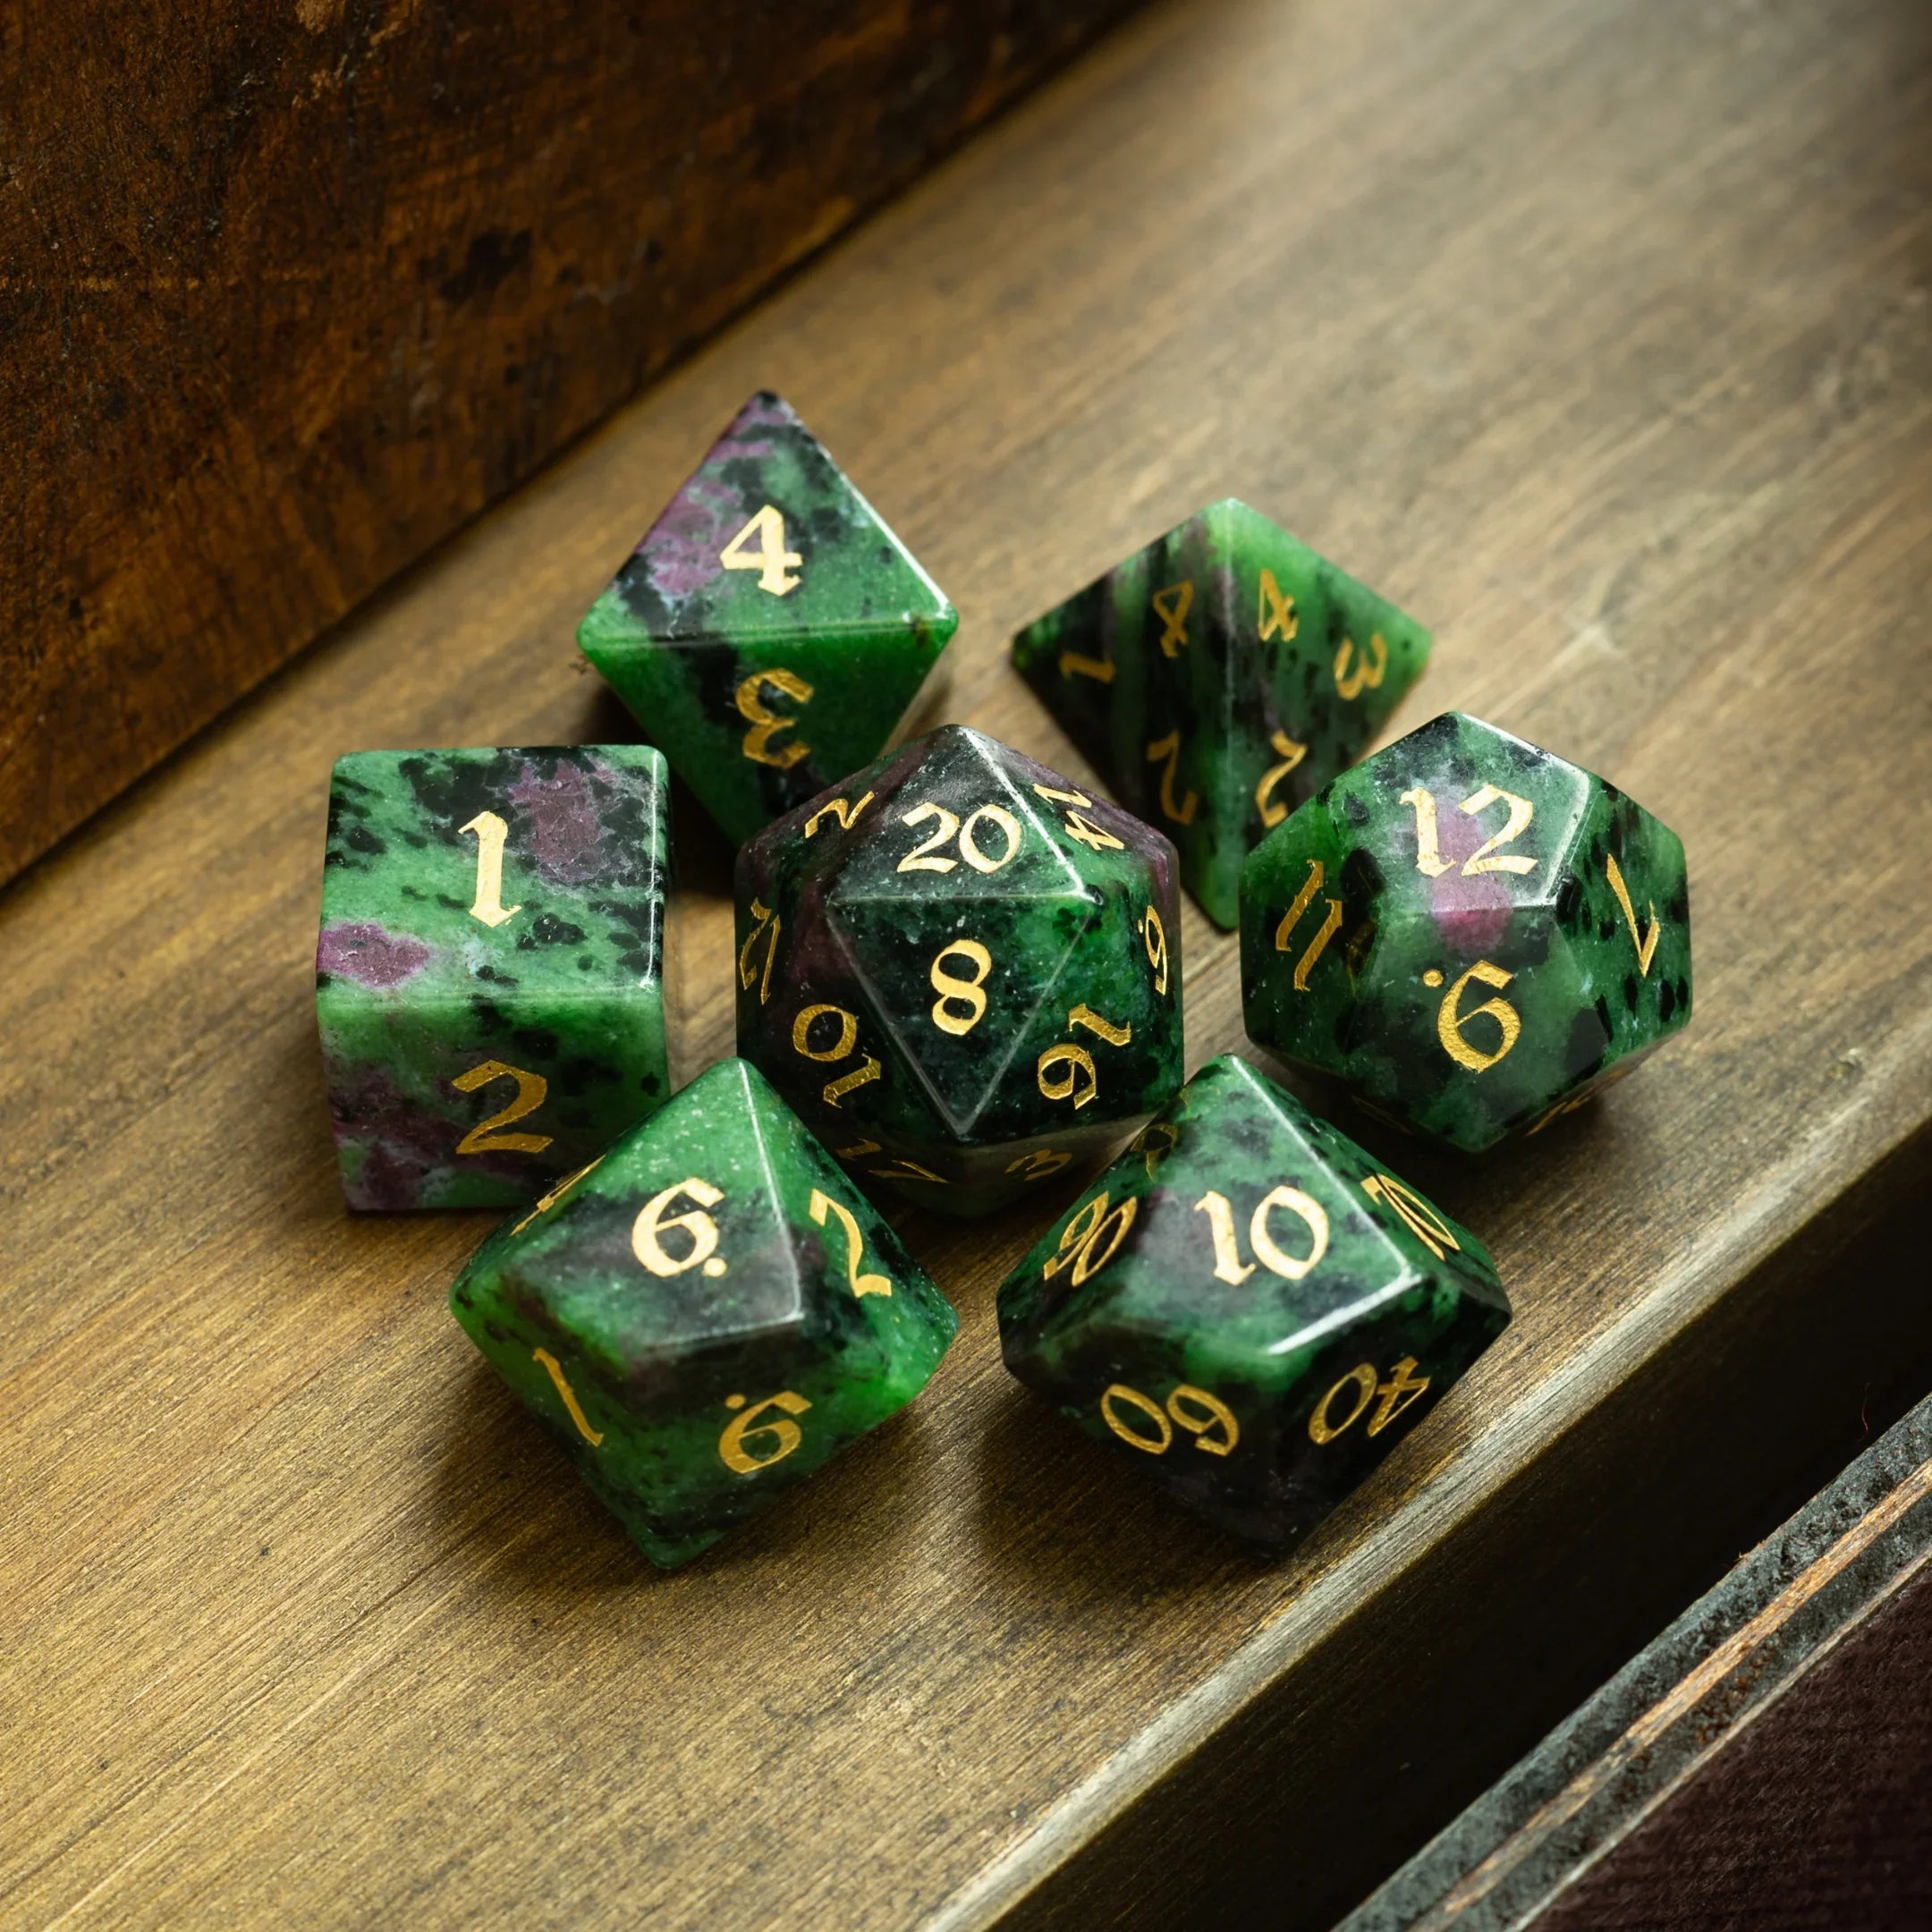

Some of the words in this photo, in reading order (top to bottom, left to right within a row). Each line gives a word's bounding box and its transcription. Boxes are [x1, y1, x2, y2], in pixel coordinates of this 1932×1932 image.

[720, 504, 802, 597] 4
[1153, 580, 1193, 657] 4
[1258, 569, 1298, 641] 4
[1334, 632, 1386, 700] 3
[735, 667, 814, 770] 3
[805, 791, 874, 838] 2
[1032, 783, 1124, 851] 14
[1256, 730, 1308, 828] 2
[458, 810, 521, 928] 1
[897, 802, 1021, 874] 20
[1400, 784, 1538, 877] 12
[931, 939, 992, 1036] 8
[452, 1059, 555, 1155] 2
[809, 1189, 892, 1298] 2
[1193, 1186, 1329, 1286] 10
[533, 1347, 604, 1447] 1
[1309, 1356, 1430, 1445] 40
